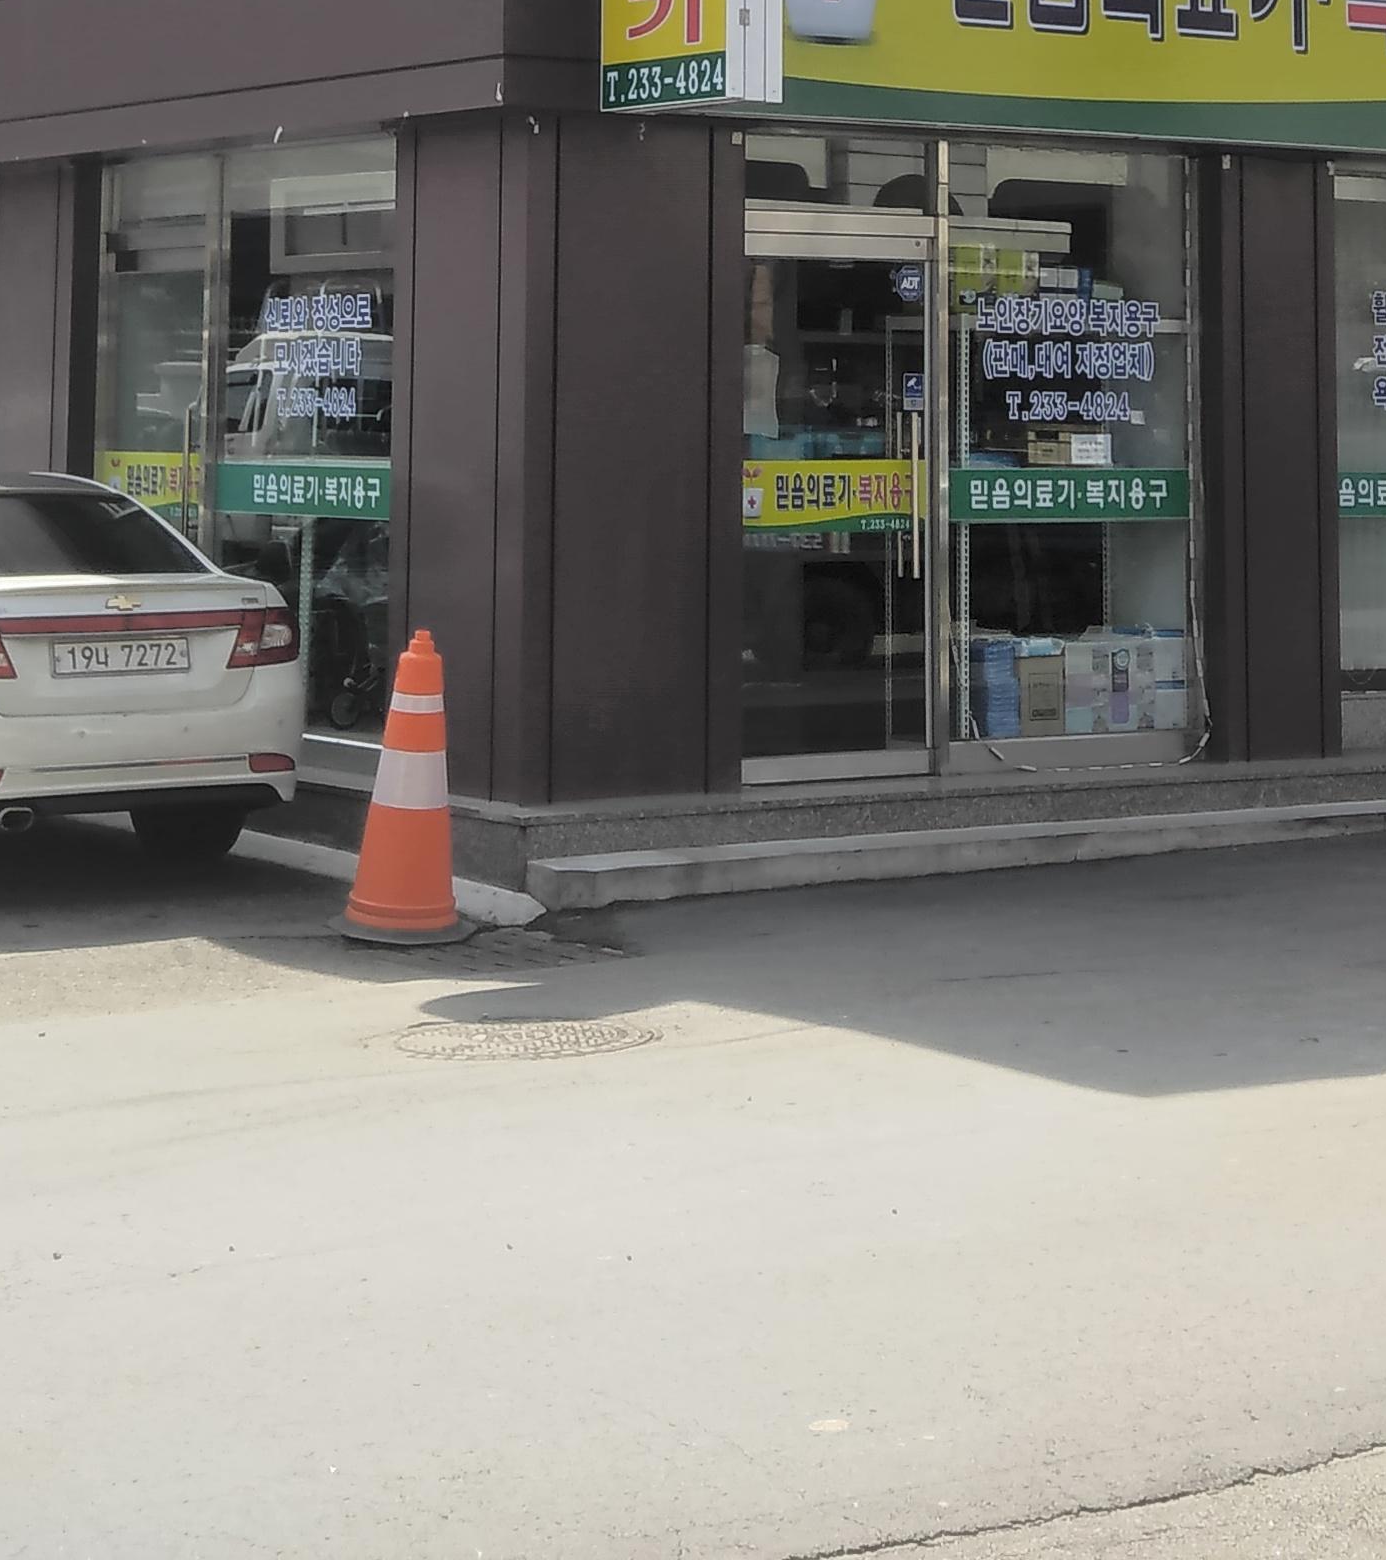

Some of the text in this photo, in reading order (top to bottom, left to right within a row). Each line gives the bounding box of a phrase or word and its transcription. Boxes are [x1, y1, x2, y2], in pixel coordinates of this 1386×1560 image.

[606, 55, 725, 104] T.233-4824
[901, 277, 920, 290] ADT
[265, 293, 373, 333] 신뢰와 정성으로
[976, 297, 1161, 338] 노인장기요양 복지용구
[273, 336, 362, 377] 모시겠습니다
[1075, 341, 1155, 382] 지정업체)
[1006, 391, 1131, 421] T.233-4824
[121, 642, 177, 669] 7272
